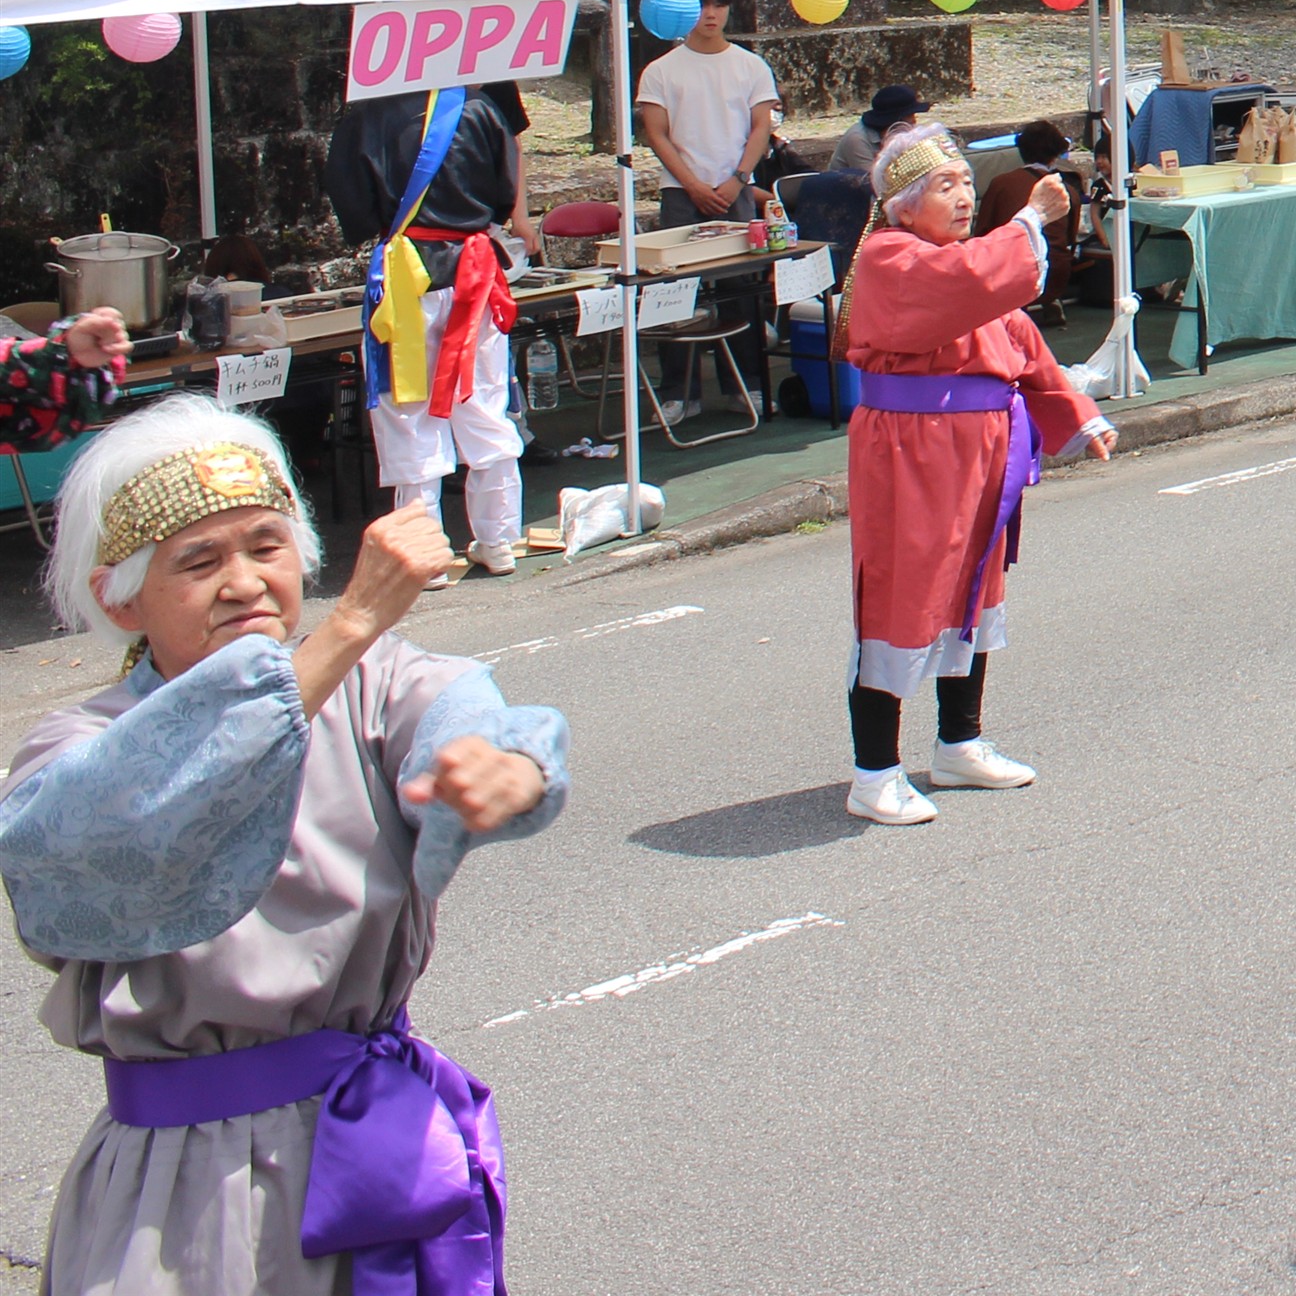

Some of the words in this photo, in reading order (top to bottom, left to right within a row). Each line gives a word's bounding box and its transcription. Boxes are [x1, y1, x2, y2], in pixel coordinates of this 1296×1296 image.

[352, 0, 567, 87] OPPA
[222, 354, 280, 378] キムチ鍋
